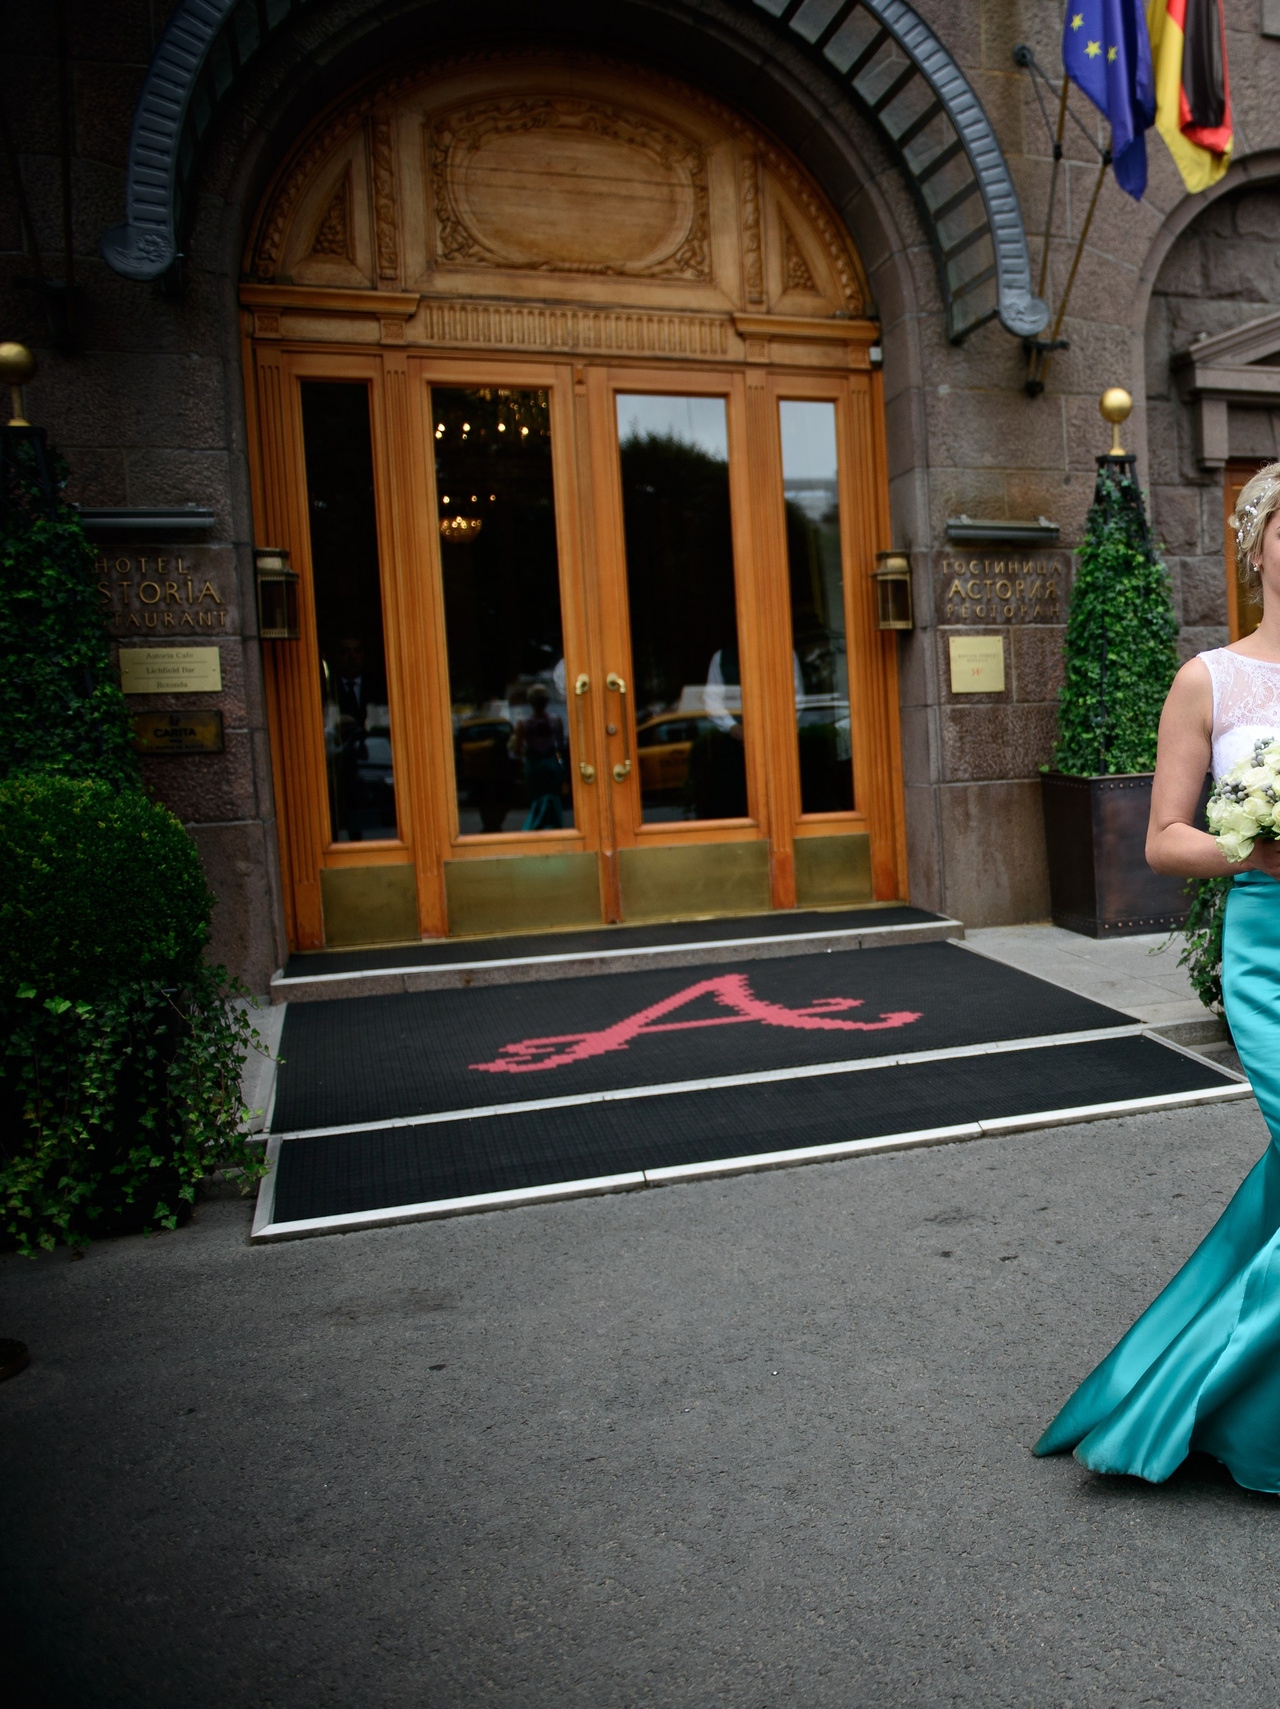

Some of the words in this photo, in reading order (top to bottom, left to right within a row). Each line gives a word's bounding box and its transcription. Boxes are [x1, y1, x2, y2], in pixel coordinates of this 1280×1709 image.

[94, 557, 189, 574] HOTEL
[943, 560, 1061, 575] ГОСТИНИЦА
[948, 578, 1057, 601] АСТОРИЯ
[947, 603, 1060, 619] РЕСТОРАН
[104, 611, 227, 628] TAURANT
[156, 681, 188, 689] Rotonda
[153, 727, 196, 738] CARITA
